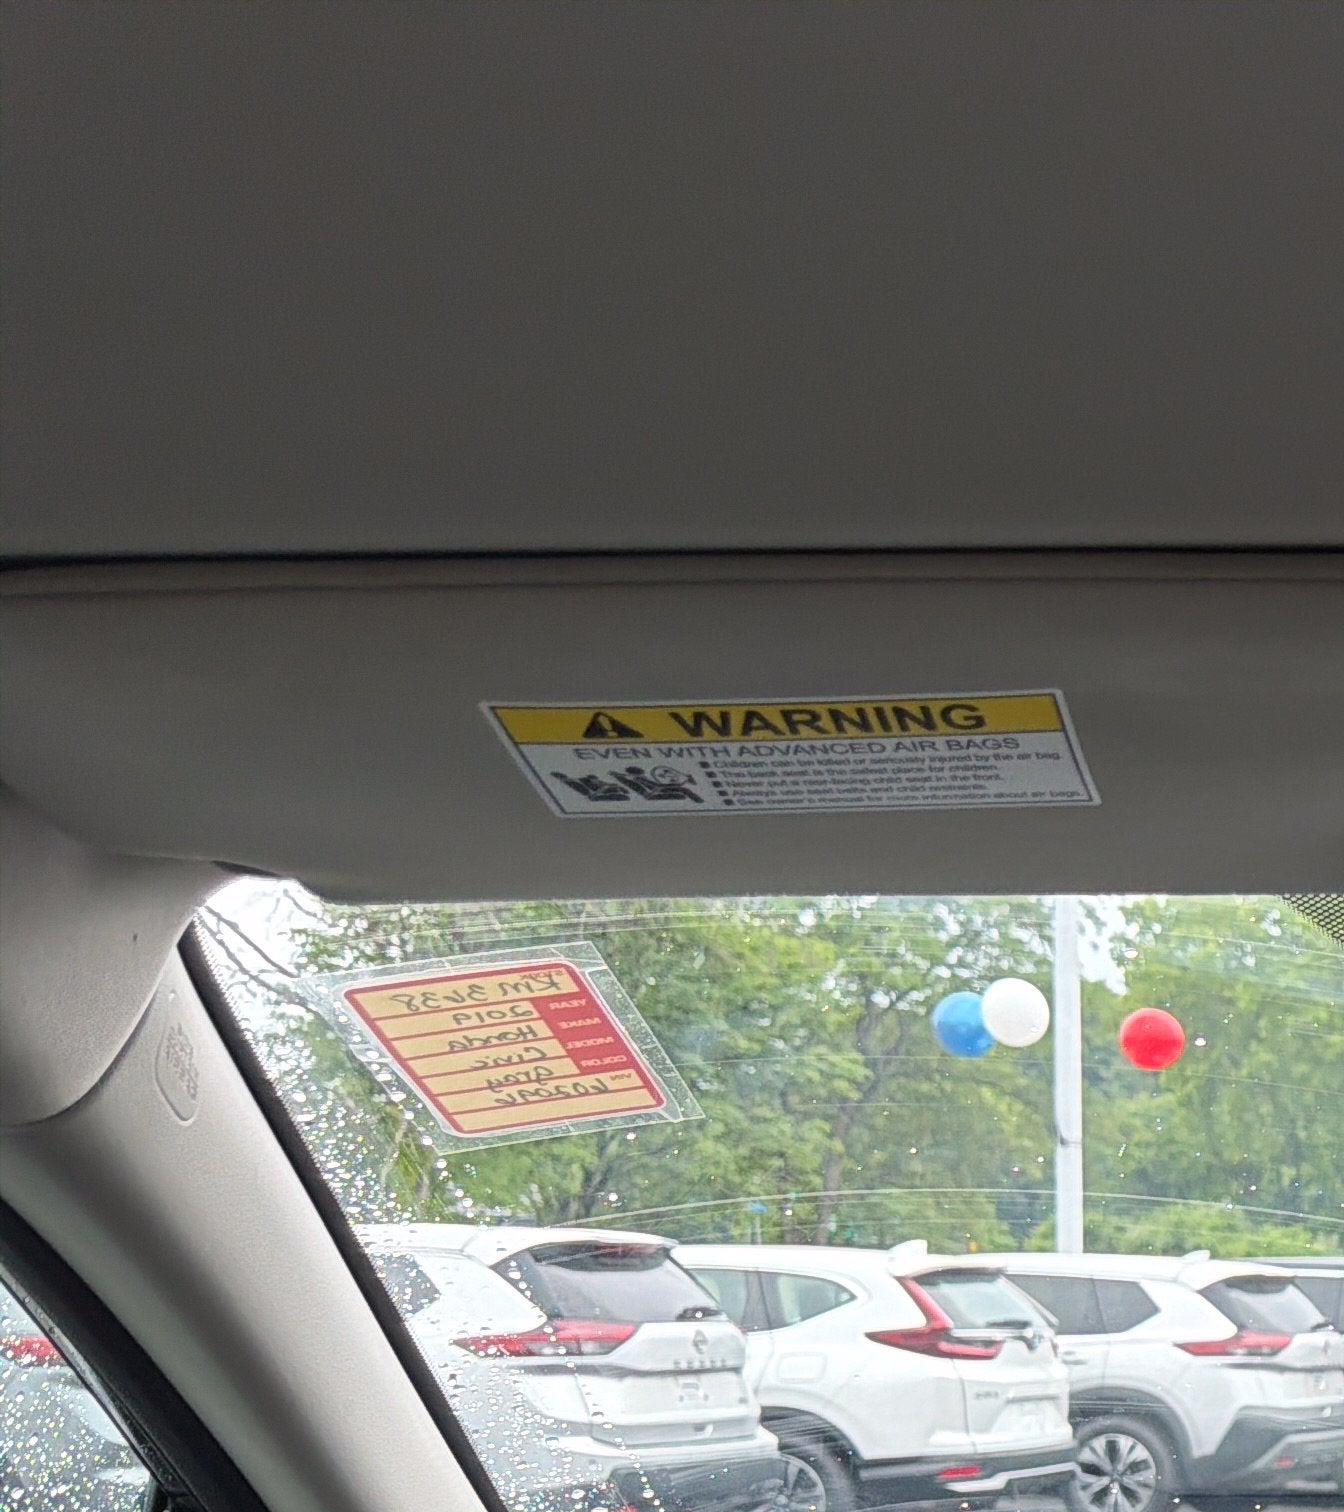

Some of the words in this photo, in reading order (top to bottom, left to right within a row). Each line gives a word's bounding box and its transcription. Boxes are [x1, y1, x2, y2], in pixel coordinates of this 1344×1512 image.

[668, 703, 987, 738] WARNING
[573, 748, 654, 761] EVEN
[657, 746, 732, 758] WITH
[738, 741, 889, 756] ADVANCED
[893, 739, 939, 751] AIR
[944, 737, 1021, 750] BAGS
